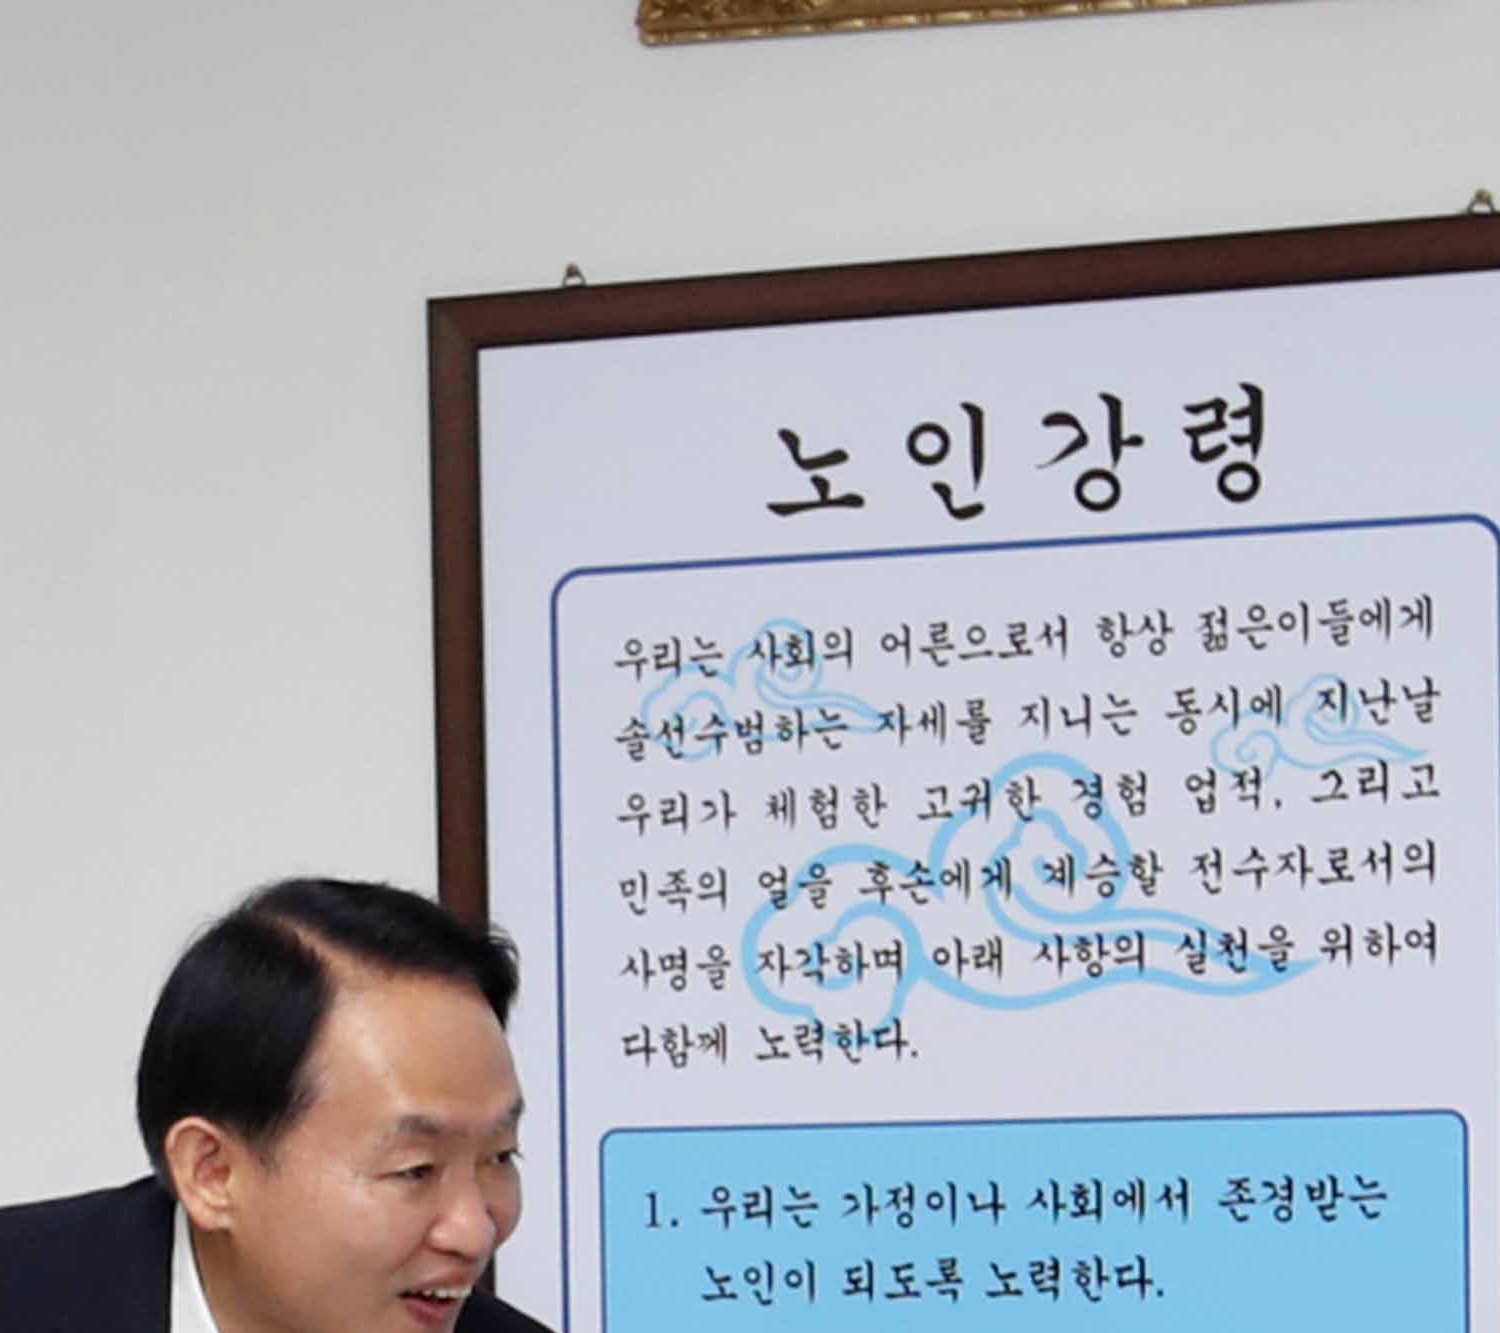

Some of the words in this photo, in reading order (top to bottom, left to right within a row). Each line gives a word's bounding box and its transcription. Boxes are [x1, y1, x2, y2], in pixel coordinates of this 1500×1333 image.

[765, 381, 1265, 522] 노인강령
[614, 636, 724, 681] 우리는
[748, 627, 853, 671] 사회의
[880, 614, 1068, 668] 어른으로서
[1096, 608, 1174, 659] 항상
[1199, 593, 1433, 653] 젊은이들에게
[614, 707, 850, 763] 솔선수범하는
[876, 698, 992, 746] 자세를
[1021, 693, 1139, 737] 지니는
[1165, 683, 1282, 737] 동시에
[1318, 675, 1441, 726] 지난날
[617, 789, 737, 836] 우리가
[767, 782, 888, 831] 체험한
[917, 775, 1042, 823] 고귀한
[1072, 770, 1148, 820] 경험
[1310, 758, 1441, 804] 그리고
[619, 866, 727, 916] 민족의
[757, 863, 833, 911] 얼을
[859, 855, 1012, 906] 후손에게
[1043, 849, 1165, 899] 계승할
[1192, 837, 1436, 896] 전수자로서의
[621, 944, 732, 993] 사명을
[758, 938, 903, 984] 자각하며
[932, 935, 1004, 980] 아래
[1033, 930, 1145, 979] 사항의
[1177, 924, 1295, 976] 실천을
[1319, 919, 1437, 966] 위하여
[621, 1022, 728, 1069] 다함께
[755, 1017, 919, 1065] 노력한다.
[645, 1191, 679, 1229] 1.
[700, 1184, 820, 1230] 우리는
[843, 1180, 1008, 1230] 가정이나
[1027, 1176, 1189, 1223] 사회에서
[1218, 1173, 1388, 1224] 존경받는
[701, 1259, 816, 1307] 노인이
[842, 1256, 964, 1303] 되도록
[985, 1254, 1164, 1304] 노력한다.
